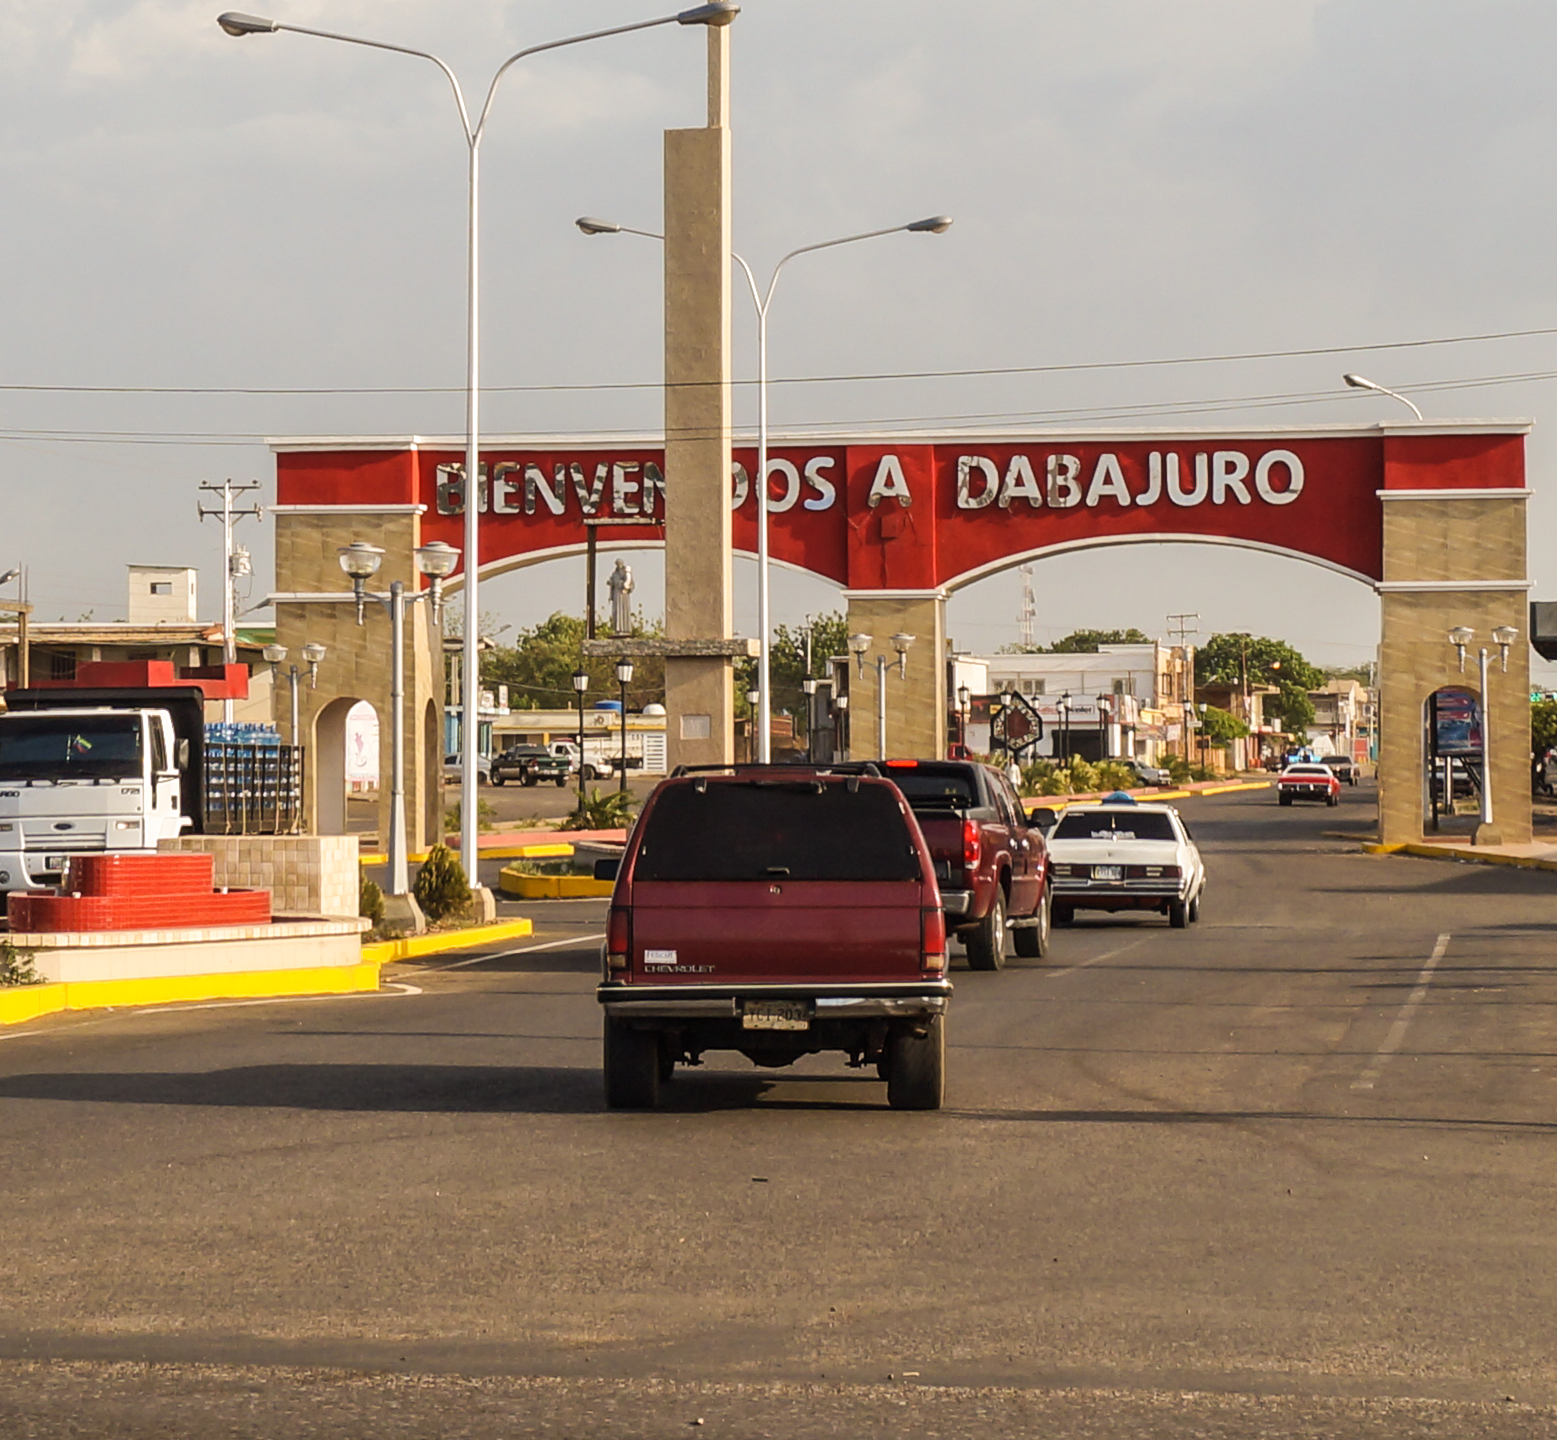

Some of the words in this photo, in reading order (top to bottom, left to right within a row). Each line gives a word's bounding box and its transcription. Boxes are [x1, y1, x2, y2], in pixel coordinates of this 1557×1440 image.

[867, 454, 912, 507] A
[957, 449, 1305, 509] DABAJURO
[644, 964, 716, 973] CHEVROLET
